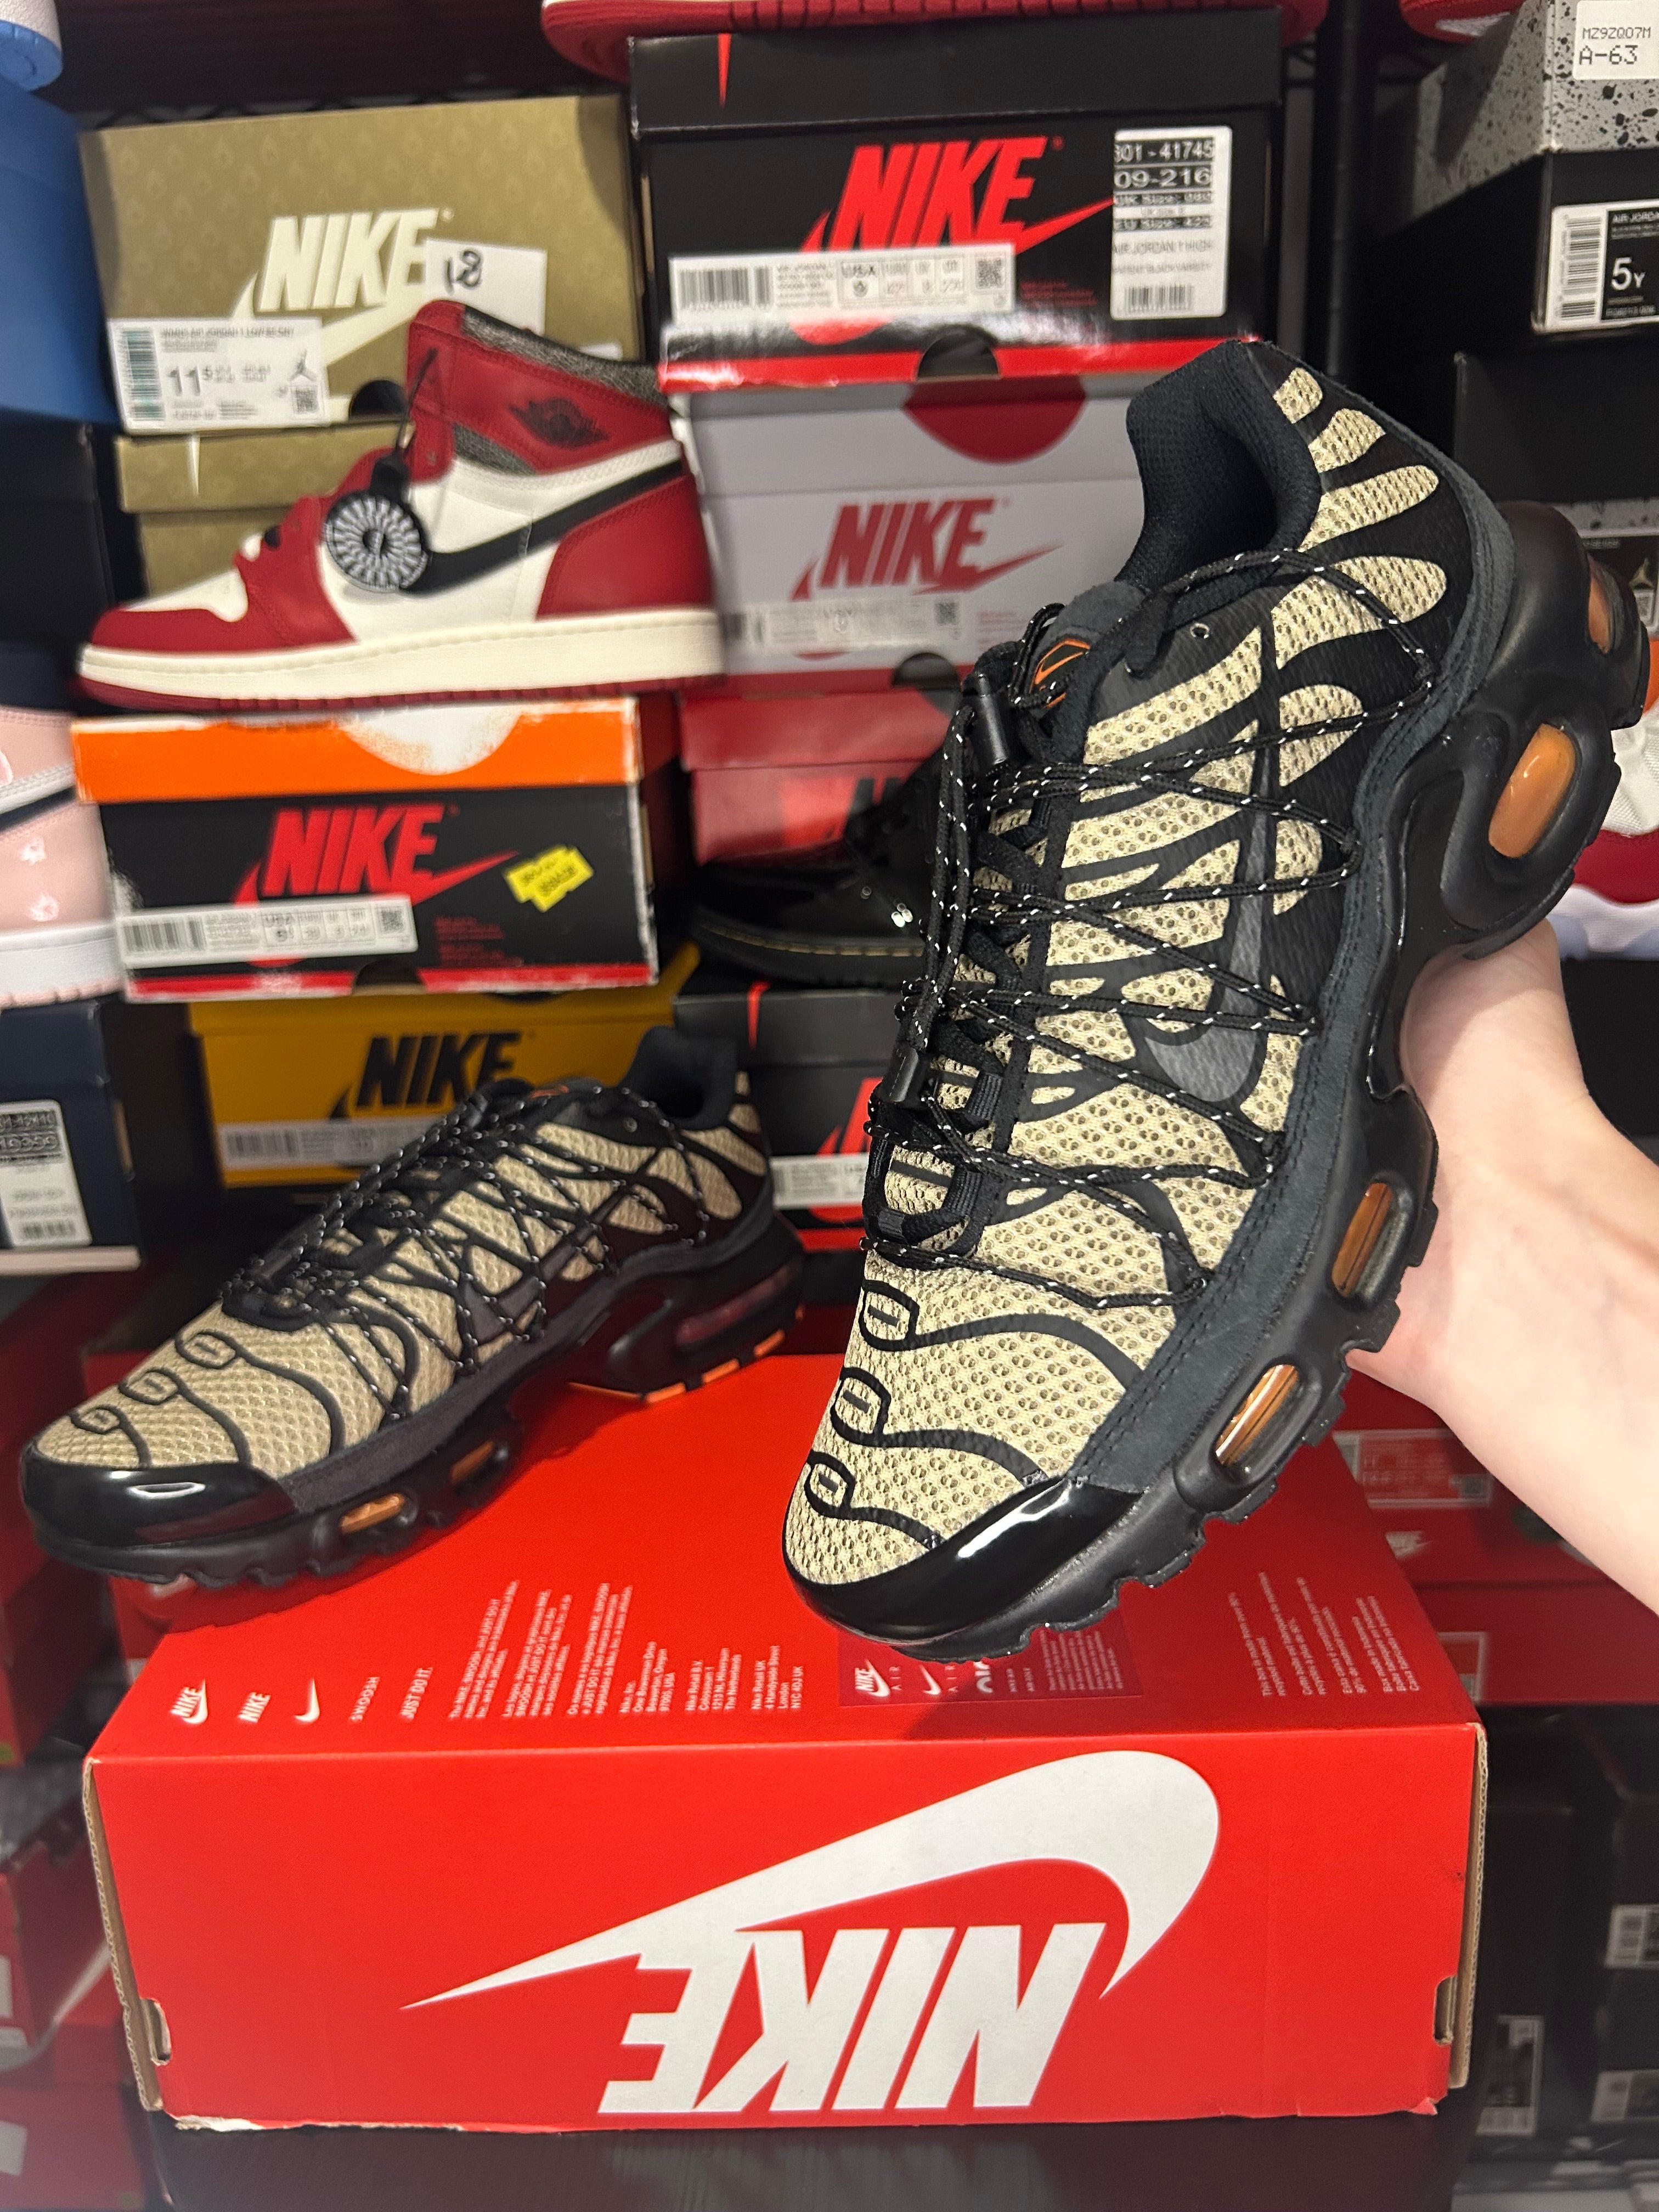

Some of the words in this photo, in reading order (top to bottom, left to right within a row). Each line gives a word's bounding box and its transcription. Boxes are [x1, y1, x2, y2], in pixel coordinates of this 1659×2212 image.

[1578, 46, 1639, 65] A-63
[1159, 140, 1214, 161] 41745
[1114, 167, 1211, 189] 09-216
[831, 137, 1046, 251] NIKE
[1131, 240, 1175, 255] JORDAN
[258, 209, 440, 312] NIKE
[821, 498, 997, 589] NIKE
[258, 803, 444, 896] NIKE
[357, 1031, 521, 1108] NIKE
[716, 1647, 730, 1681] Hilversum
[755, 1660, 765, 1671] UK
[768, 1645, 780, 1666] Street
[587, 1676, 599, 1687] DO
[662, 1672, 676, 1688] USA
[727, 1654, 741, 1695] Netherlands
[753, 1672, 764, 1691] Retail
[793, 1666, 803, 1677] UK
[855, 1667, 877, 1692] NIKE
[891, 1666, 902, 1691] AIR
[946, 1665, 958, 1692] AIR
[407, 1679, 430, 1693] DO
[688, 1673, 700, 1693] Retail
[699, 1672, 713, 1710] Colosseum
[715, 1682, 725, 1692] NL
[765, 1667, 778, 1703] Handyside
[792, 1678, 802, 1691] 4DJ
[1379, 1678, 1392, 1692] Box
[170, 1686, 202, 1718] NIKE
[348, 1677, 380, 1723] SWOOSH
[514, 1683, 534, 1716] SWOOSH
[582, 1689, 596, 1707] JUST
[631, 1697, 646, 1712] One
[685, 1695, 697, 1710] Nike
[712, 1694, 724, 1709] 1213
[725, 1696, 736, 1710] The
[751, 1693, 762, 1709] Nike
[778, 1682, 789, 1708] London
[237, 1691, 271, 1723] NIKE
[395, 1694, 426, 1719] JUST
[449, 1704, 463, 1717] The
[598, 1923, 1106, 2113] NIKE
